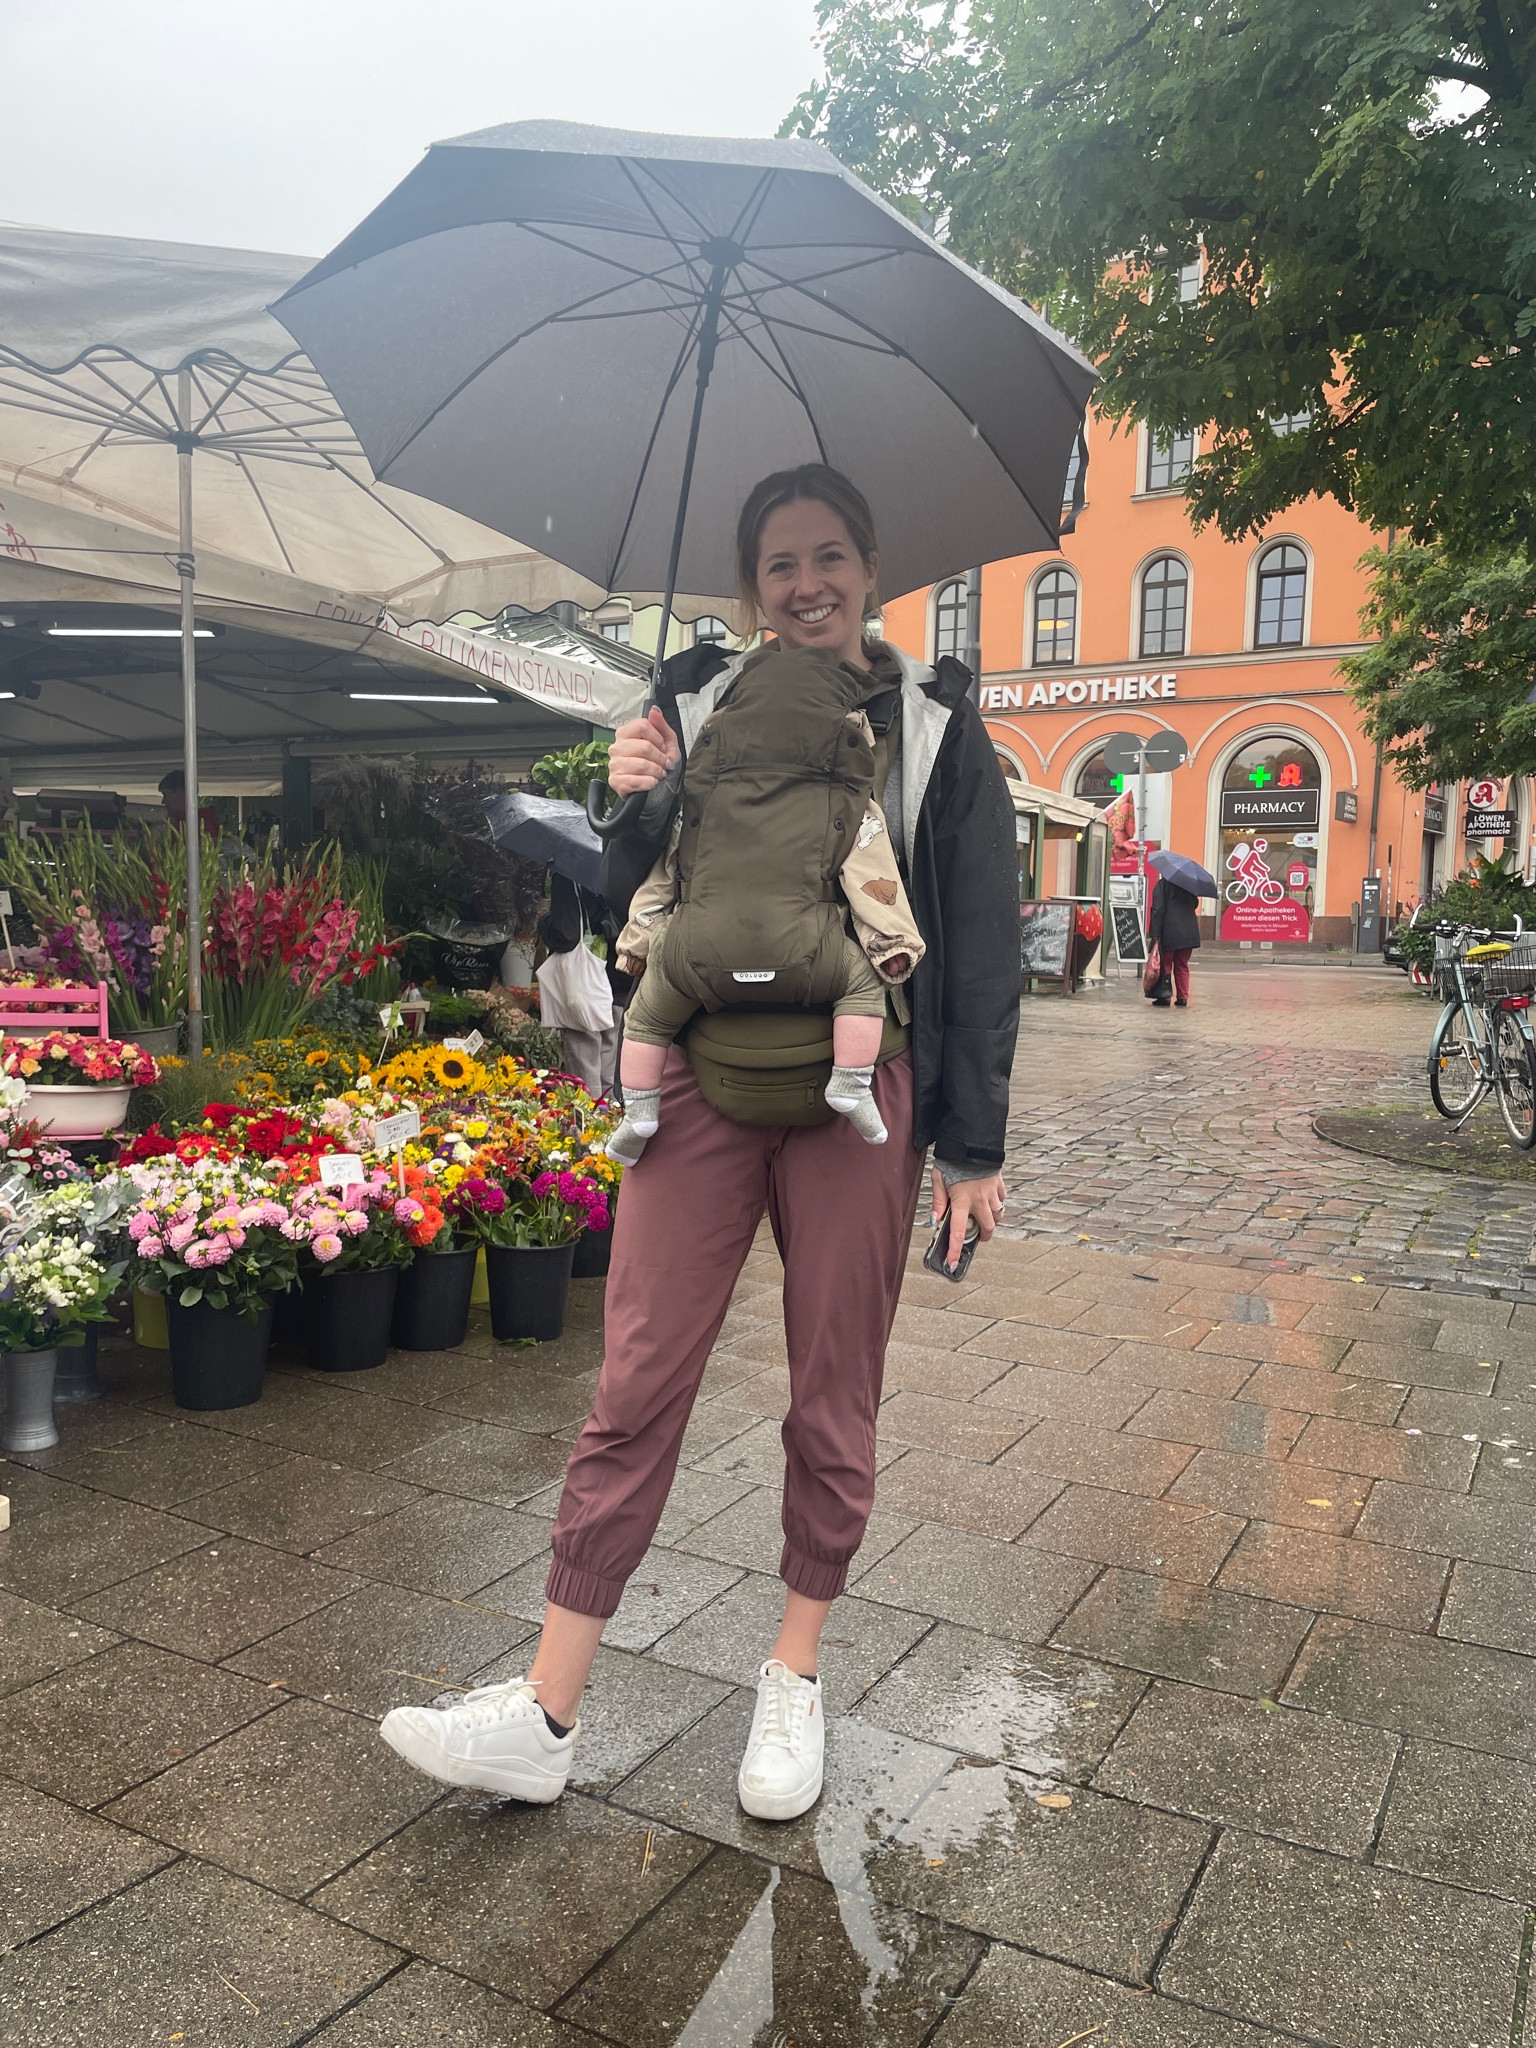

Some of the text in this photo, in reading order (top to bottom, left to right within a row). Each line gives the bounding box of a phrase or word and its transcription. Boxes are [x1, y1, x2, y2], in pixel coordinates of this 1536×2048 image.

[1028, 674, 1177, 706] APOTHEKE
[1234, 802, 1306, 814] PHARMACY
[1474, 814, 1505, 822] LÖWEN
[1468, 821, 1511, 829] APOTHEKE
[1235, 906, 1296, 914] Online-Apotheken
